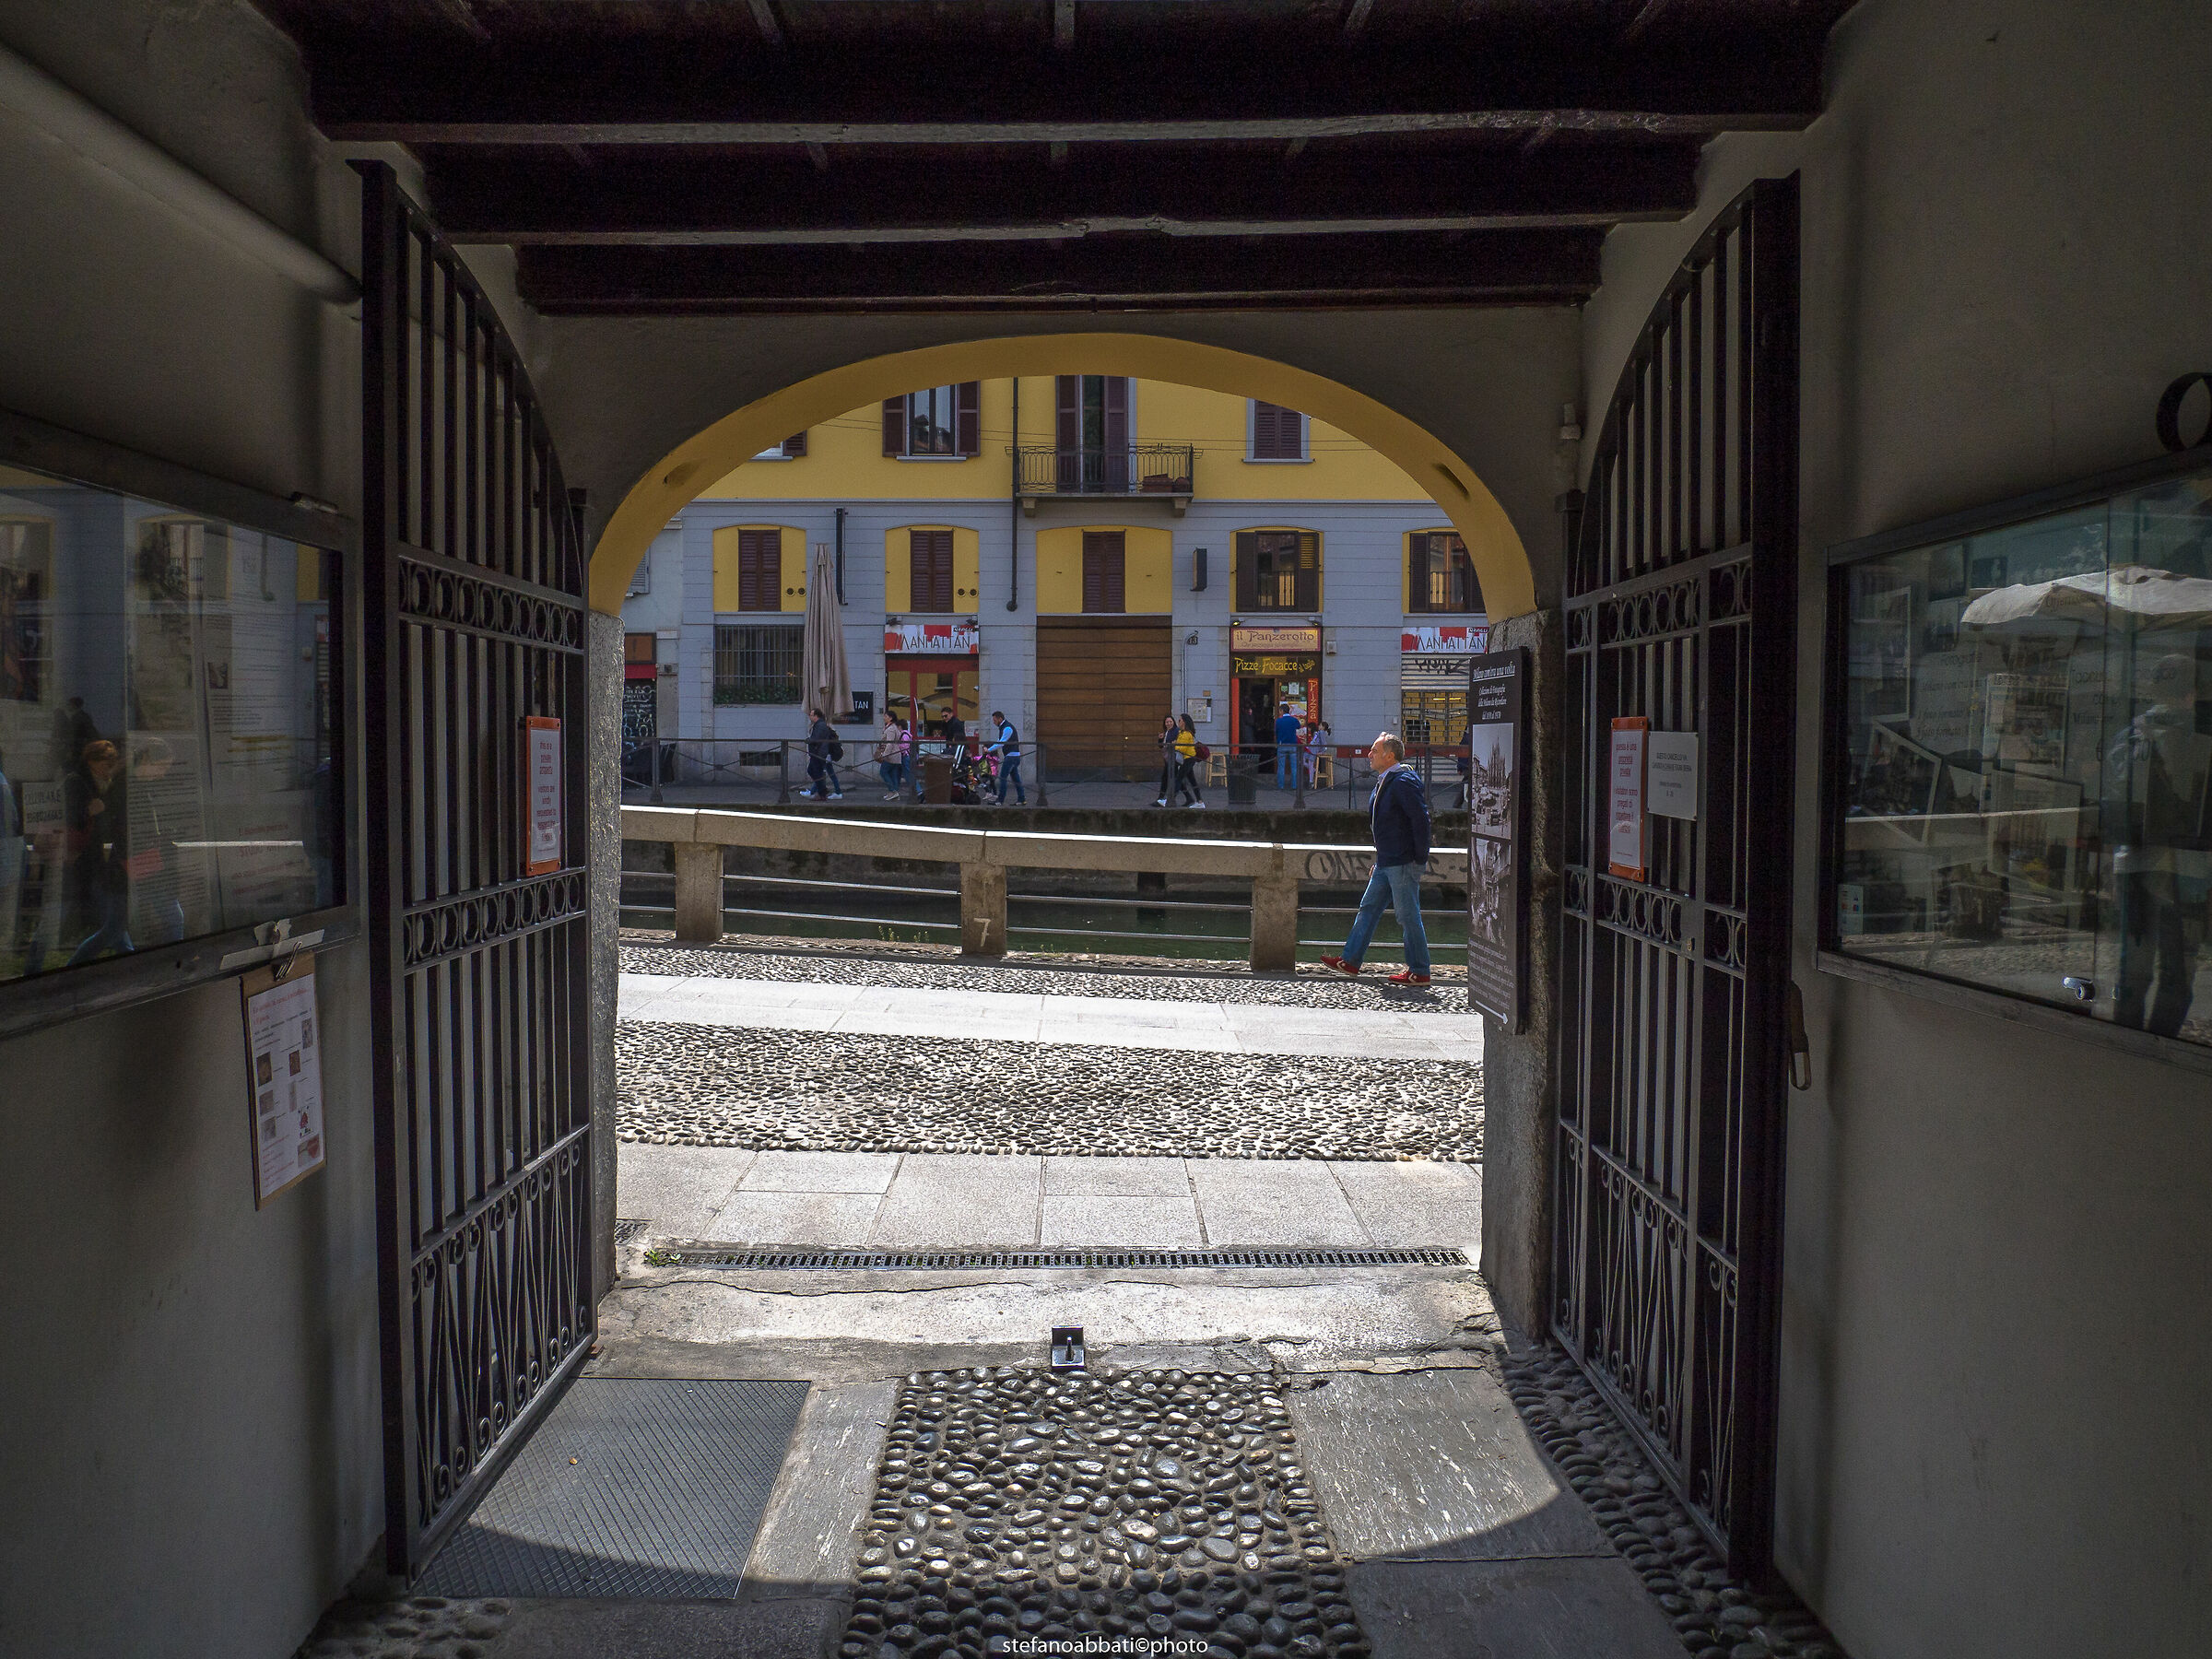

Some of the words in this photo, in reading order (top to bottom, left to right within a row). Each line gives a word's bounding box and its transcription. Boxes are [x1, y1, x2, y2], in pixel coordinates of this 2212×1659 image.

[897, 634, 971, 650] MANHATTAN
[1236, 630, 1242, 641] il
[1247, 630, 1314, 642] Panzerotto
[1412, 635, 1485, 651] MANHATTAN
[1309, 679, 1318, 720] Pizza
[973, 917, 992, 947] 7
